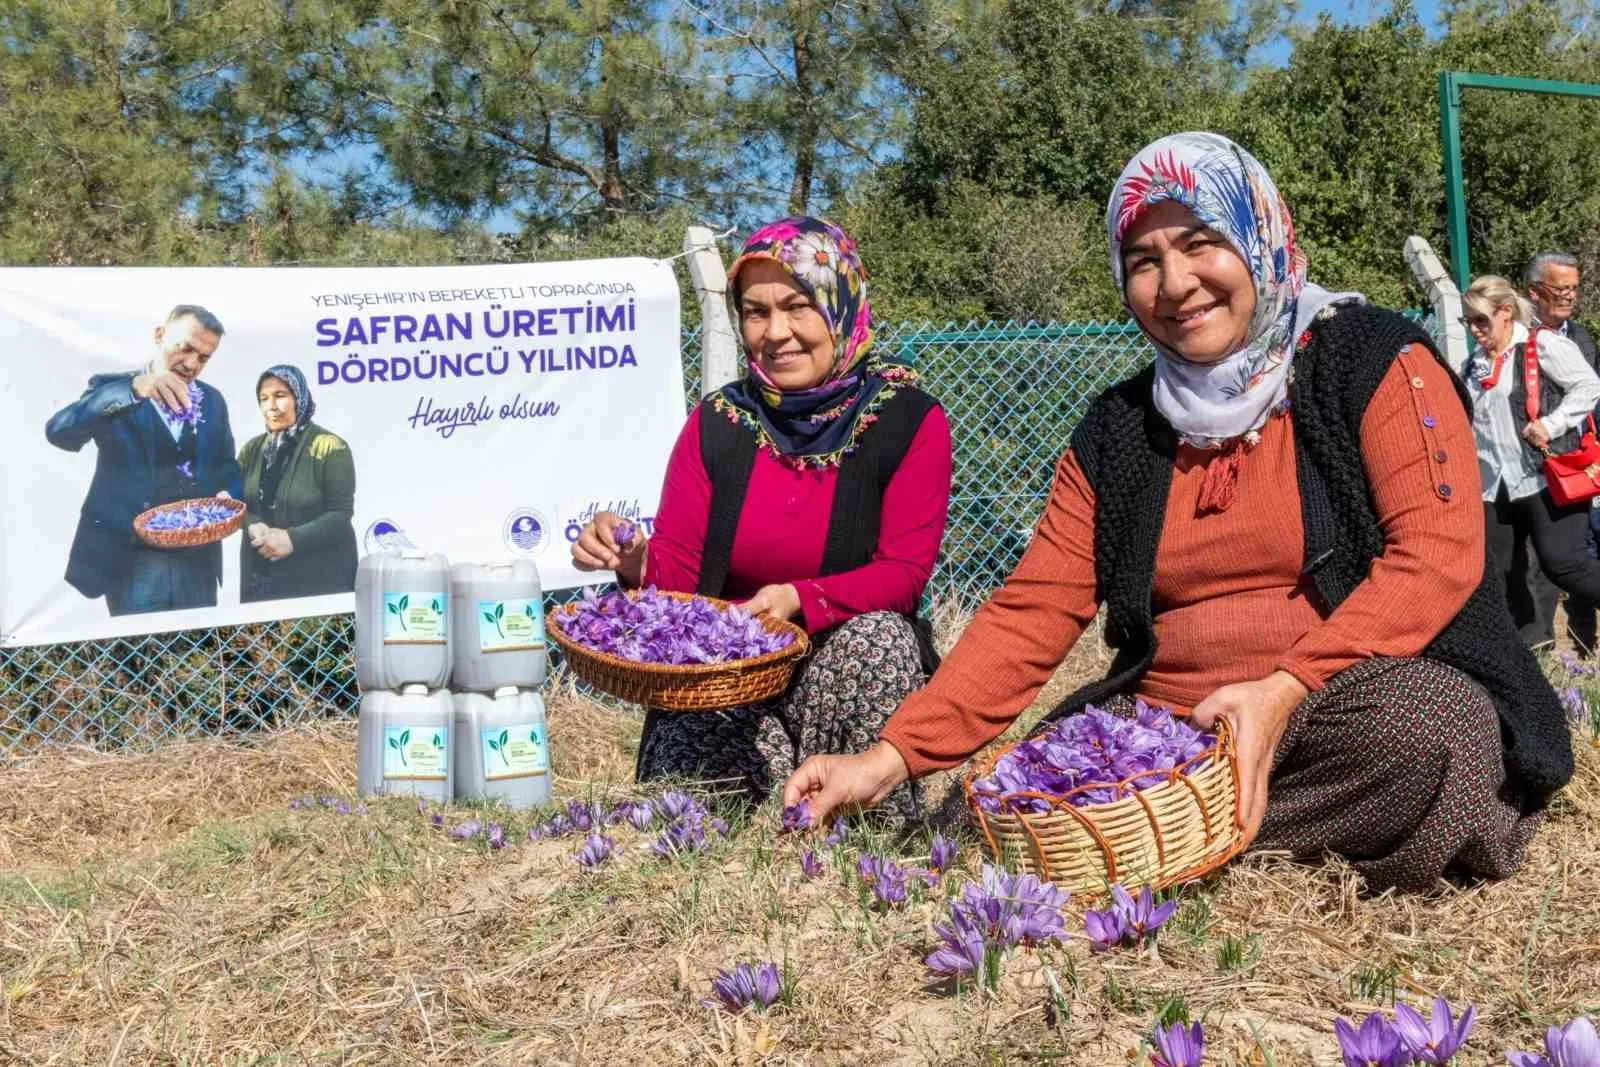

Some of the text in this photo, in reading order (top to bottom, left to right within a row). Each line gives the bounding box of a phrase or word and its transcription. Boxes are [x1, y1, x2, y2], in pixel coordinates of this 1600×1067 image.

[527, 281, 637, 298] TOPRAĞINDA
[315, 298, 636, 348] SAFRAN ÜRETİMİ
[317, 344, 639, 386] DÖRDÜNCÜ YILINDA
[408, 393, 561, 439] Hayırlı olsun
